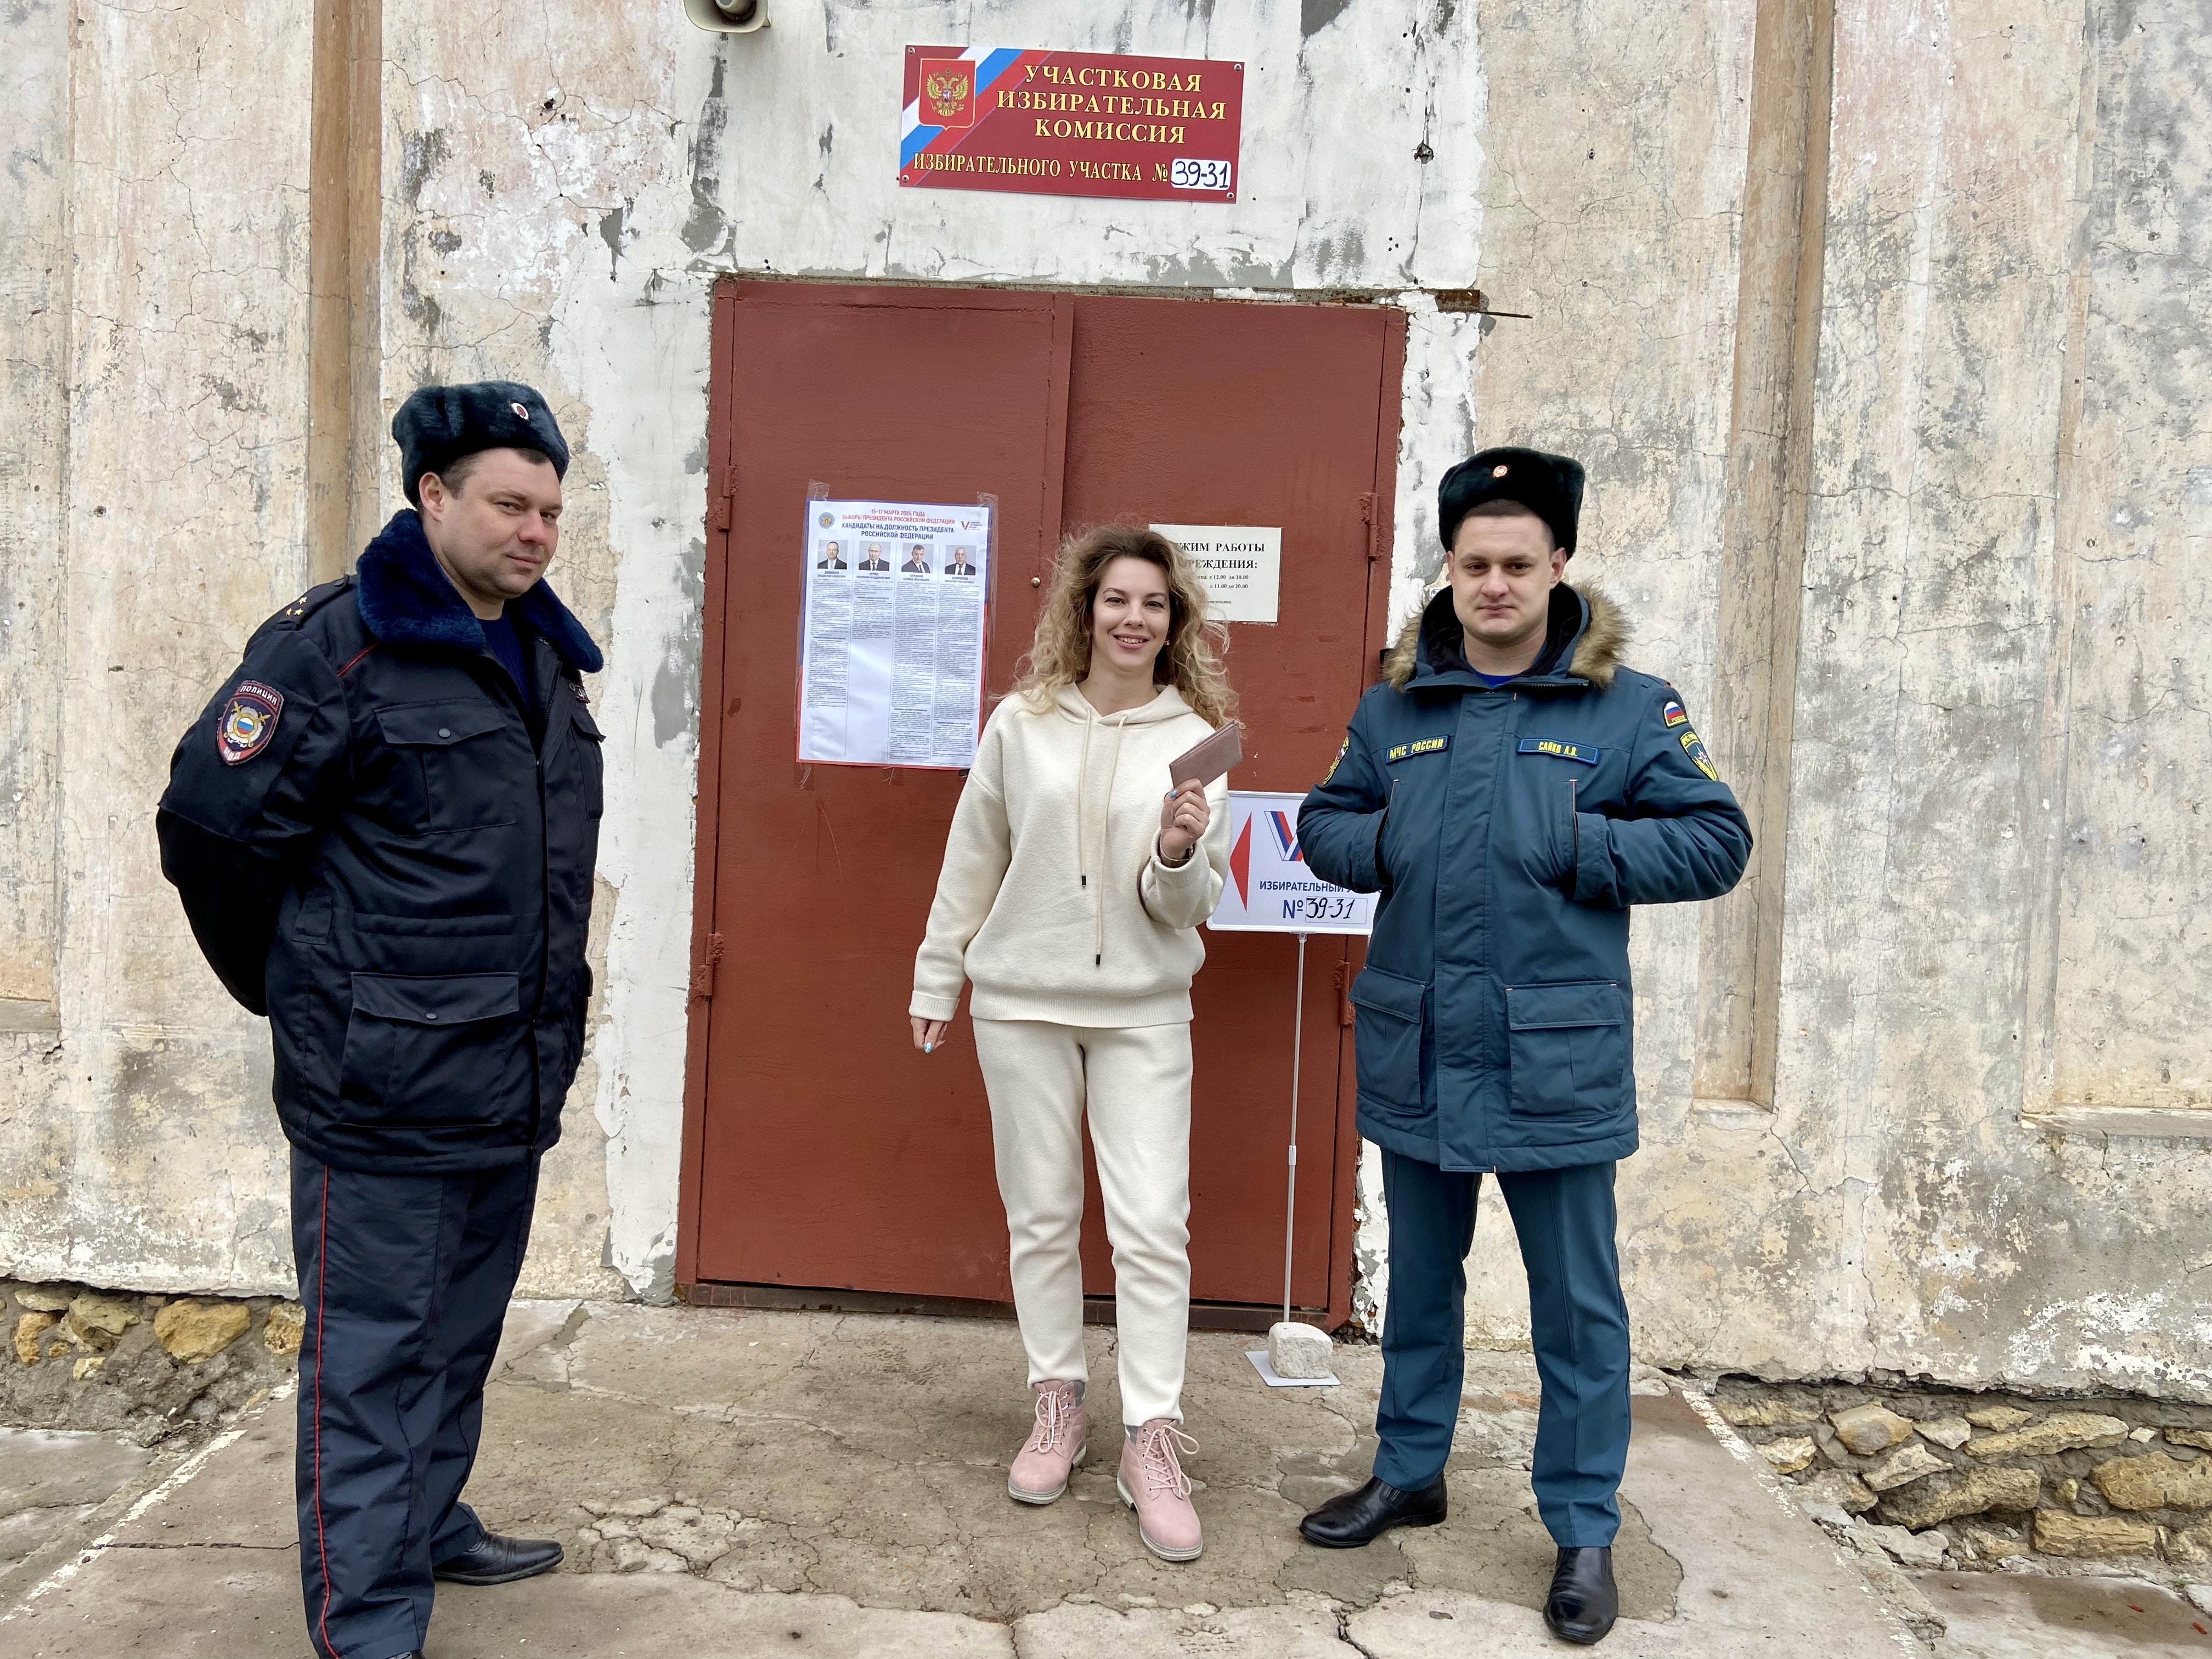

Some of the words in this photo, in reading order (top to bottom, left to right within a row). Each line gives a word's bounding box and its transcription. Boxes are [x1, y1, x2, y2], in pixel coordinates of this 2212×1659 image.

[1024, 64, 1202, 92] УЧАСТКОВАЯ
[996, 91, 1227, 120] ИЗБИРАТЕЛЬНАЯ
[1034, 119, 1186, 144] КОМИССИЯ
[913, 153, 1060, 177] ИЗБИРАТЕЛЬНОГО
[1069, 161, 1142, 182] УЧАСТКА
[1152, 163, 1169, 183] №
[1171, 160, 1230, 189] 39-31
[1177, 543, 1210, 551] ЖИМ
[1216, 543, 1265, 552] РАБОТЫ
[240, 685, 278, 706] ПОЛИЦИЯ
[223, 747, 241, 760] МВД
[1389, 745, 1407, 760] МЧС
[1410, 738, 1444, 754] РОССИИ
[1306, 897, 1356, 919] 39-31
